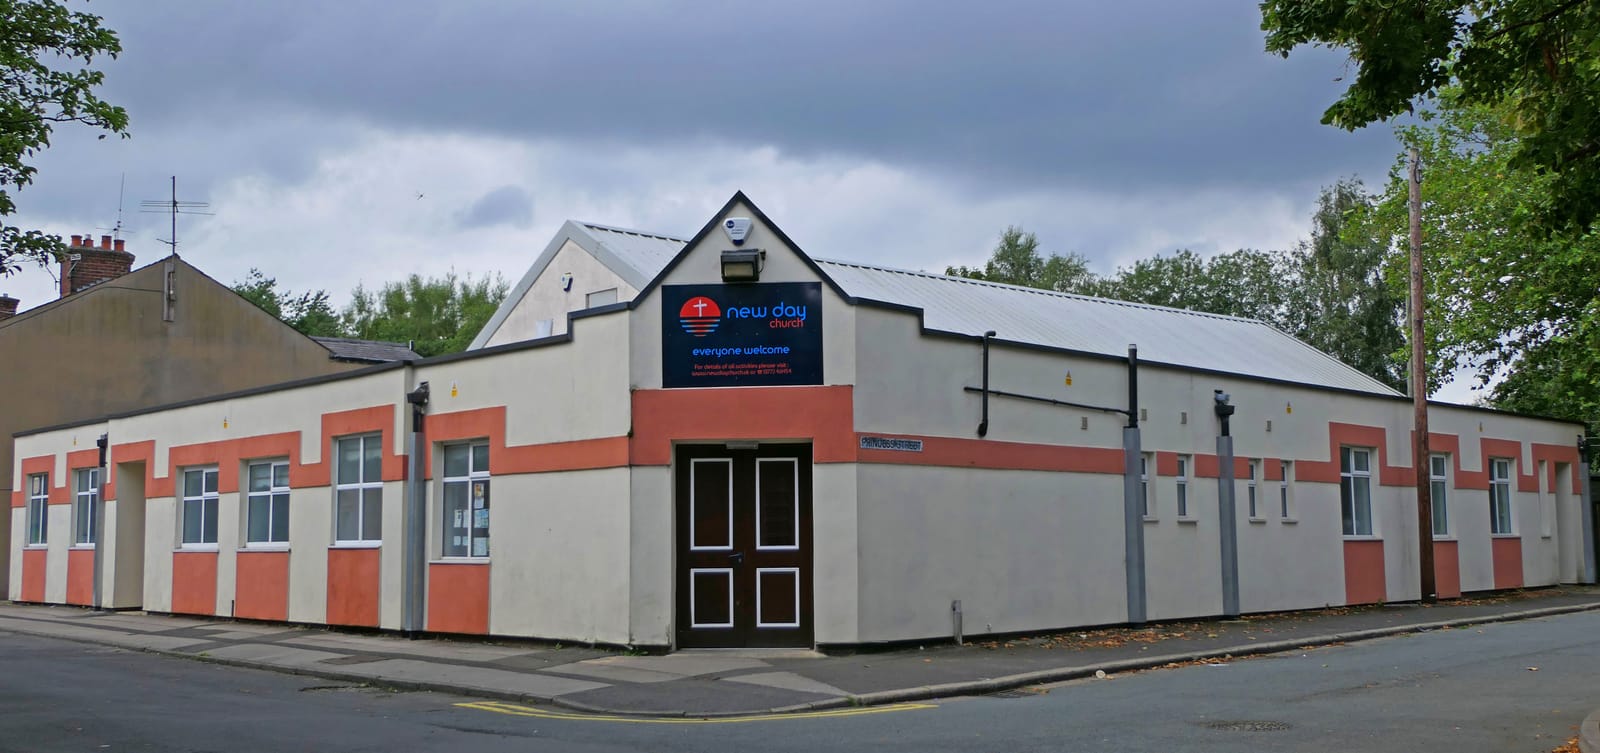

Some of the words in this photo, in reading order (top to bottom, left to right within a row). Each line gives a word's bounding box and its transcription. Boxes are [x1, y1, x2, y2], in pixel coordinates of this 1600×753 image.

[727, 306, 767, 318] new
[772, 301, 807, 320] day
[769, 318, 804, 328] church
[692, 347, 742, 357] everyone
[743, 345, 790, 355] welcome
[862, 437, 896, 448] PRINCESS
[896, 440, 921, 450] STREET
